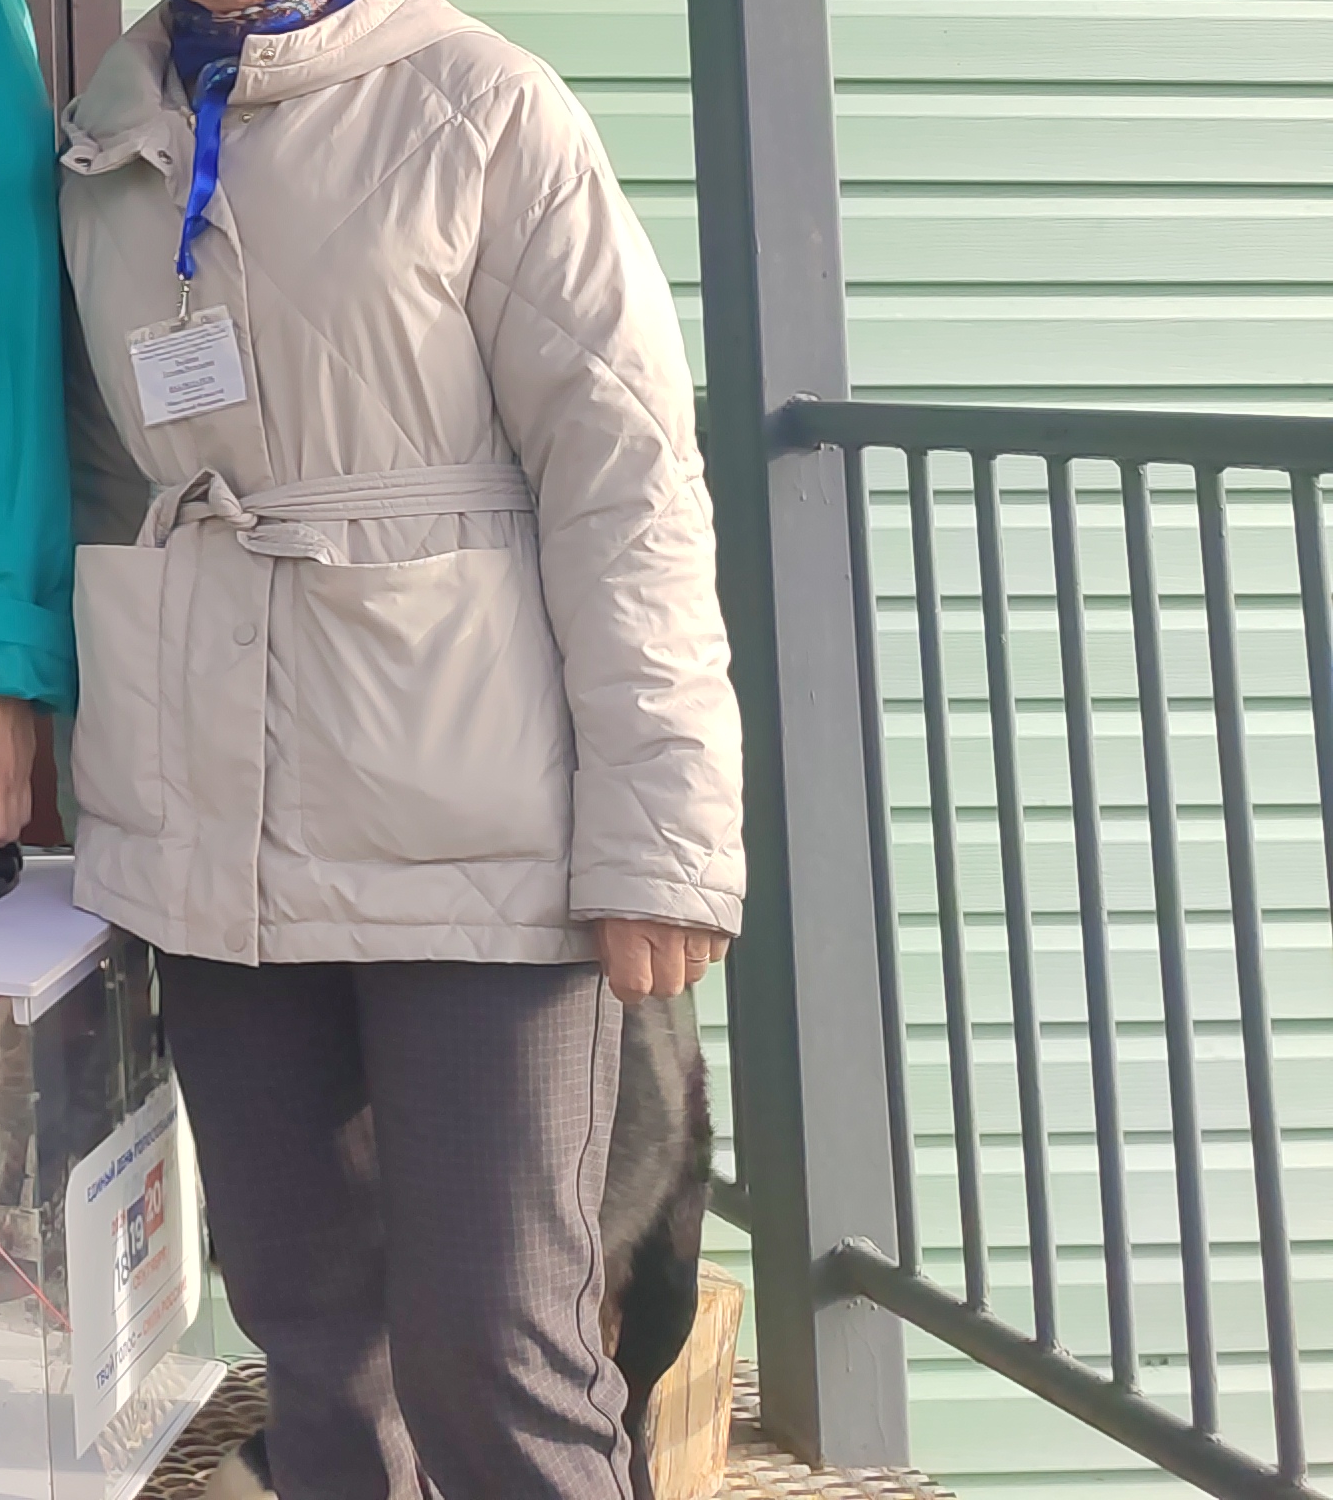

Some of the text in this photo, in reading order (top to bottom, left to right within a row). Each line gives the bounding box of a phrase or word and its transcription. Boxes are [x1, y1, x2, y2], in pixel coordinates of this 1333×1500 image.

[114, 1180, 163, 1292] 18 19 20
